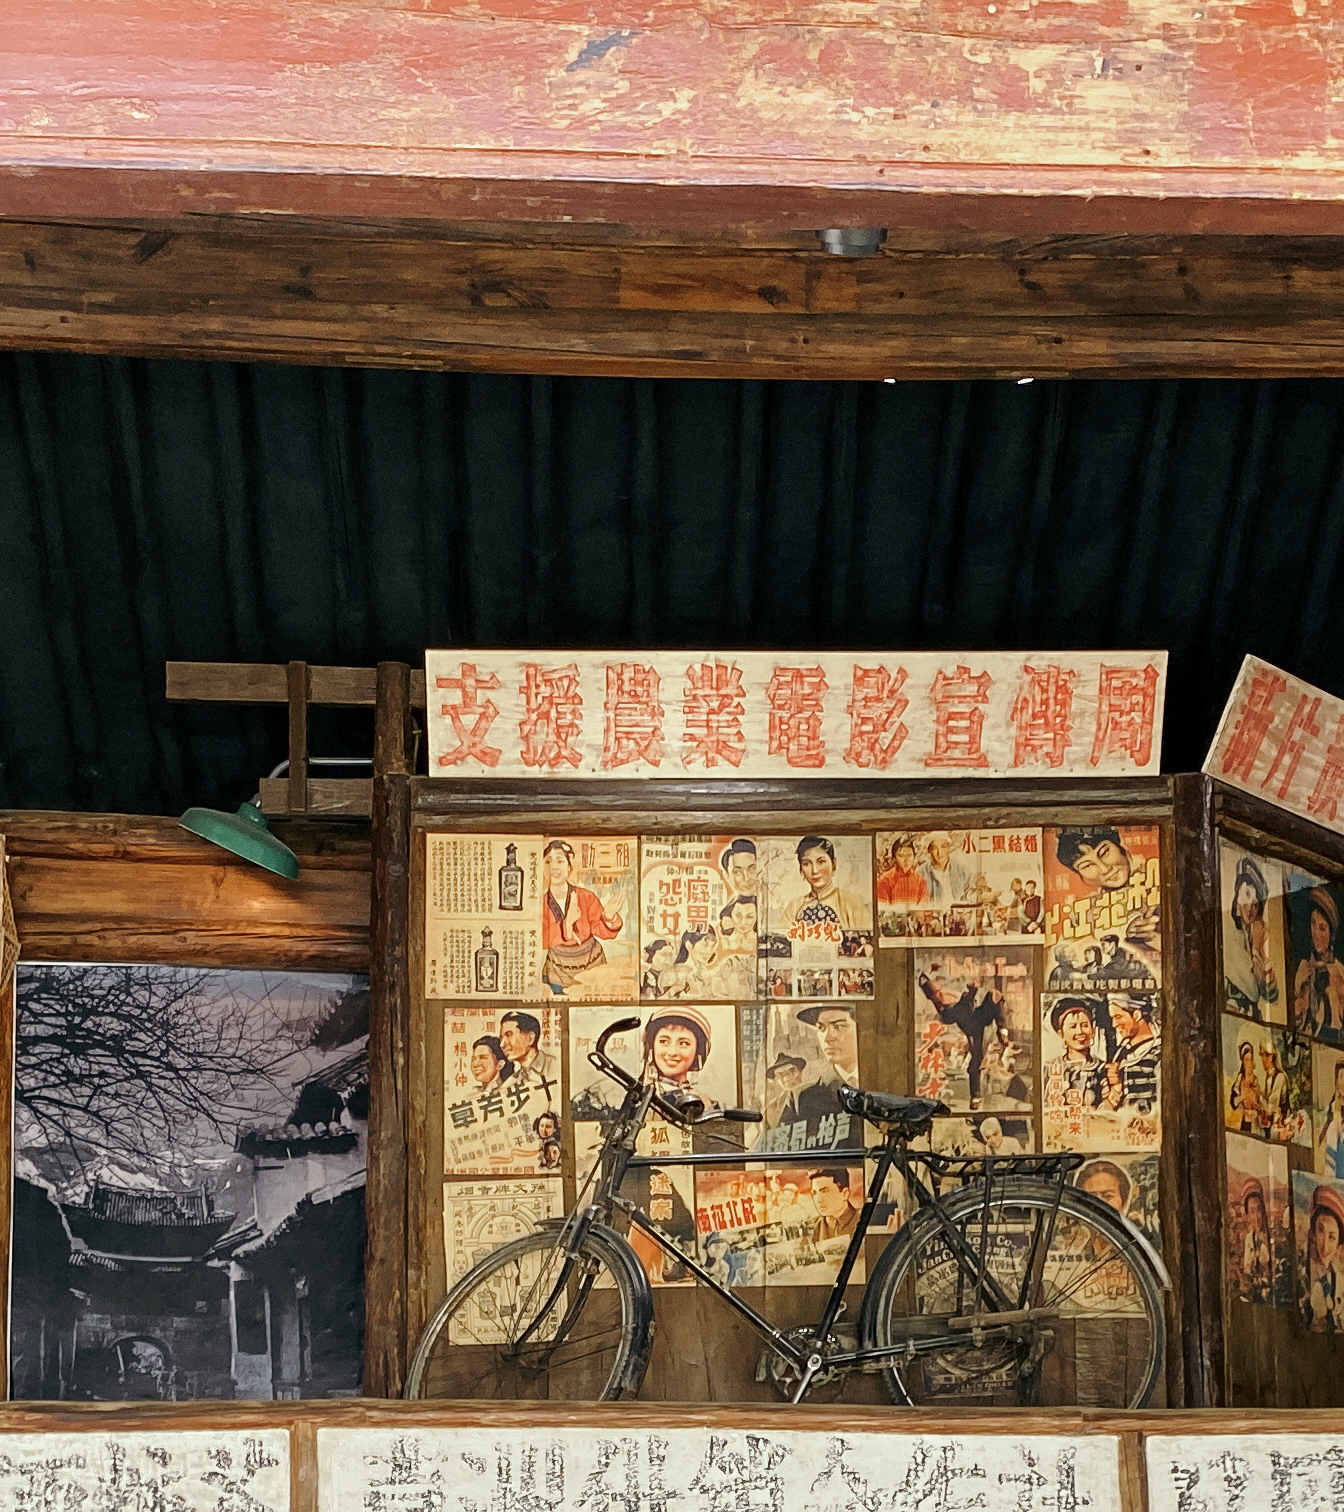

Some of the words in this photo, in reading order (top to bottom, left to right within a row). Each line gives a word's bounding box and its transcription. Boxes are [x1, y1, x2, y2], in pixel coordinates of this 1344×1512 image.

[436, 660, 1160, 769] 支援農業電影宣傳周
